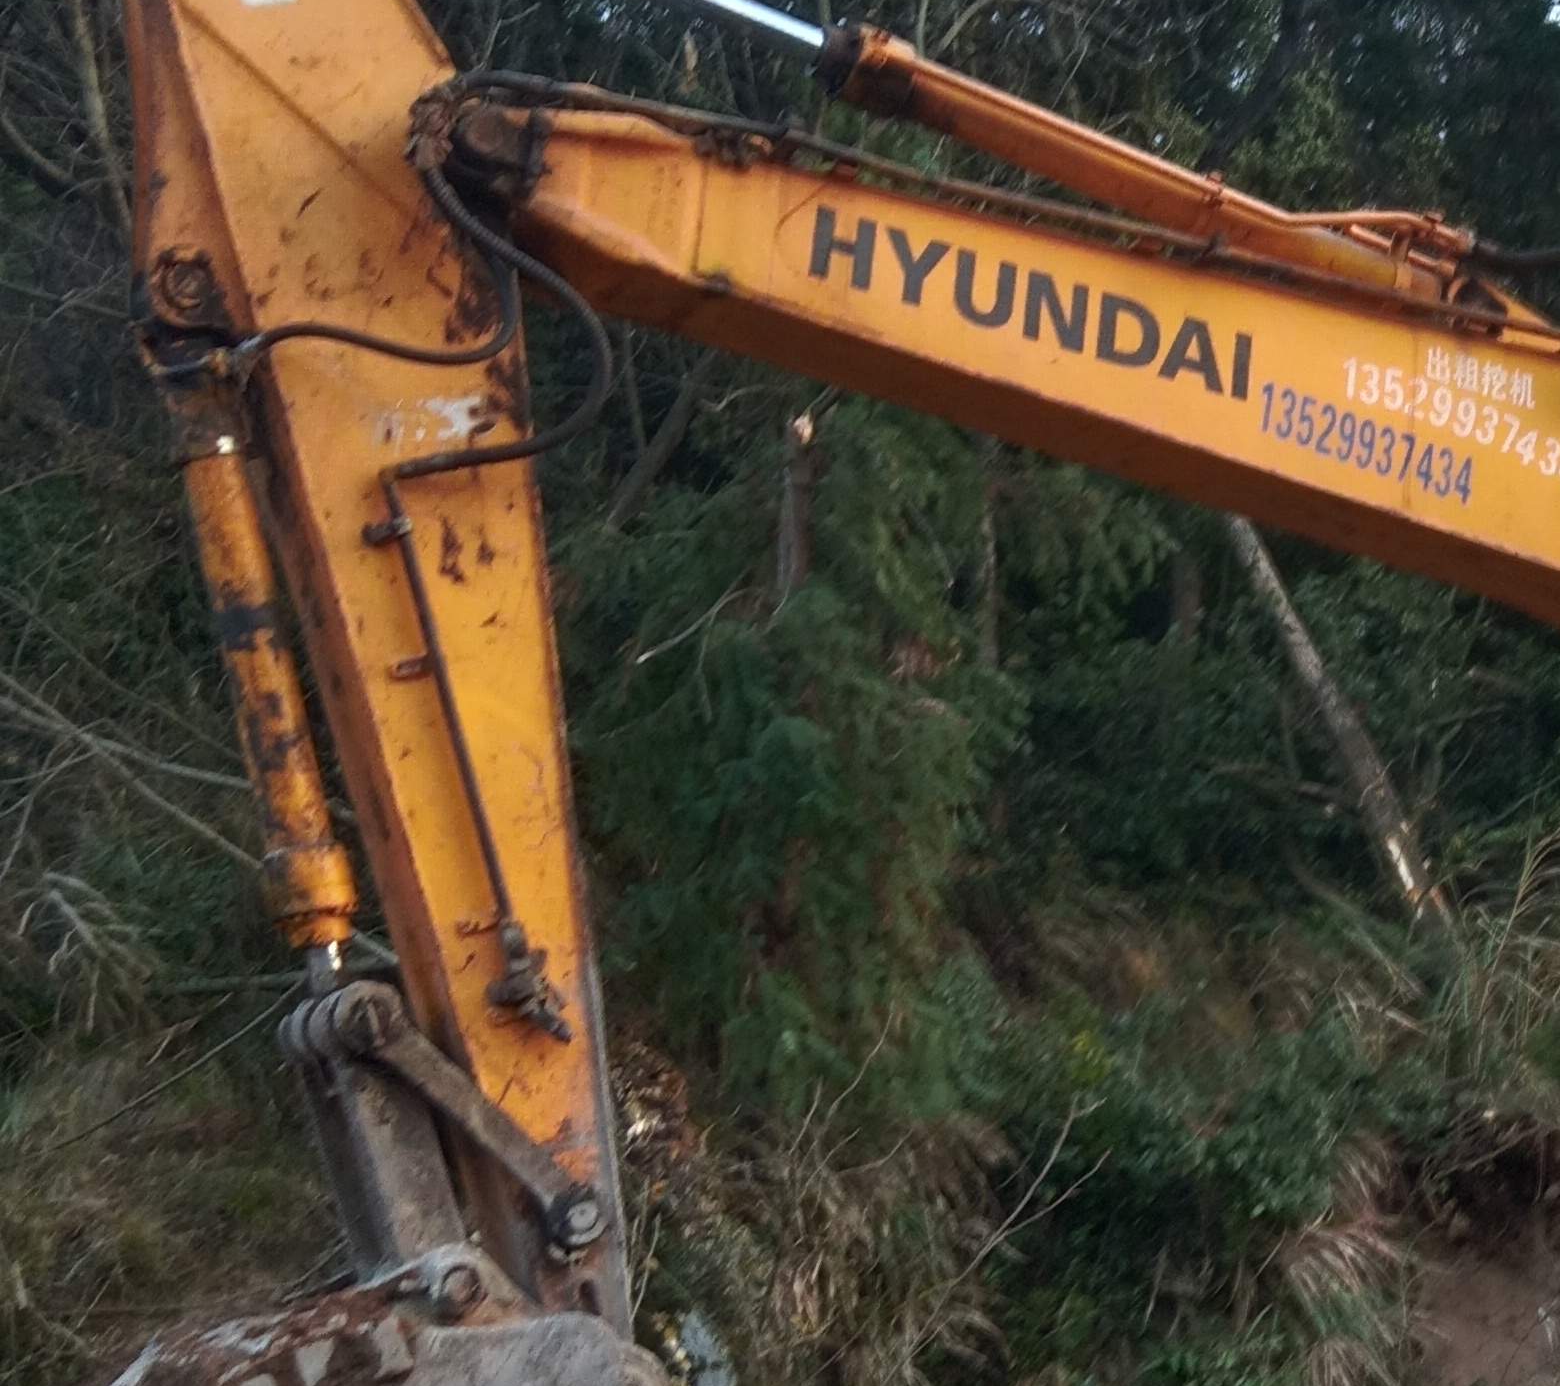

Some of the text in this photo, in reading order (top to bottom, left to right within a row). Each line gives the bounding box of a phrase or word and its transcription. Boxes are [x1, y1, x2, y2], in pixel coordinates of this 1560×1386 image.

[808, 204, 1253, 402] HYUNDAI
[1425, 346, 1536, 410] 出租挖机
[1262, 382, 1473, 506] 13529937434
